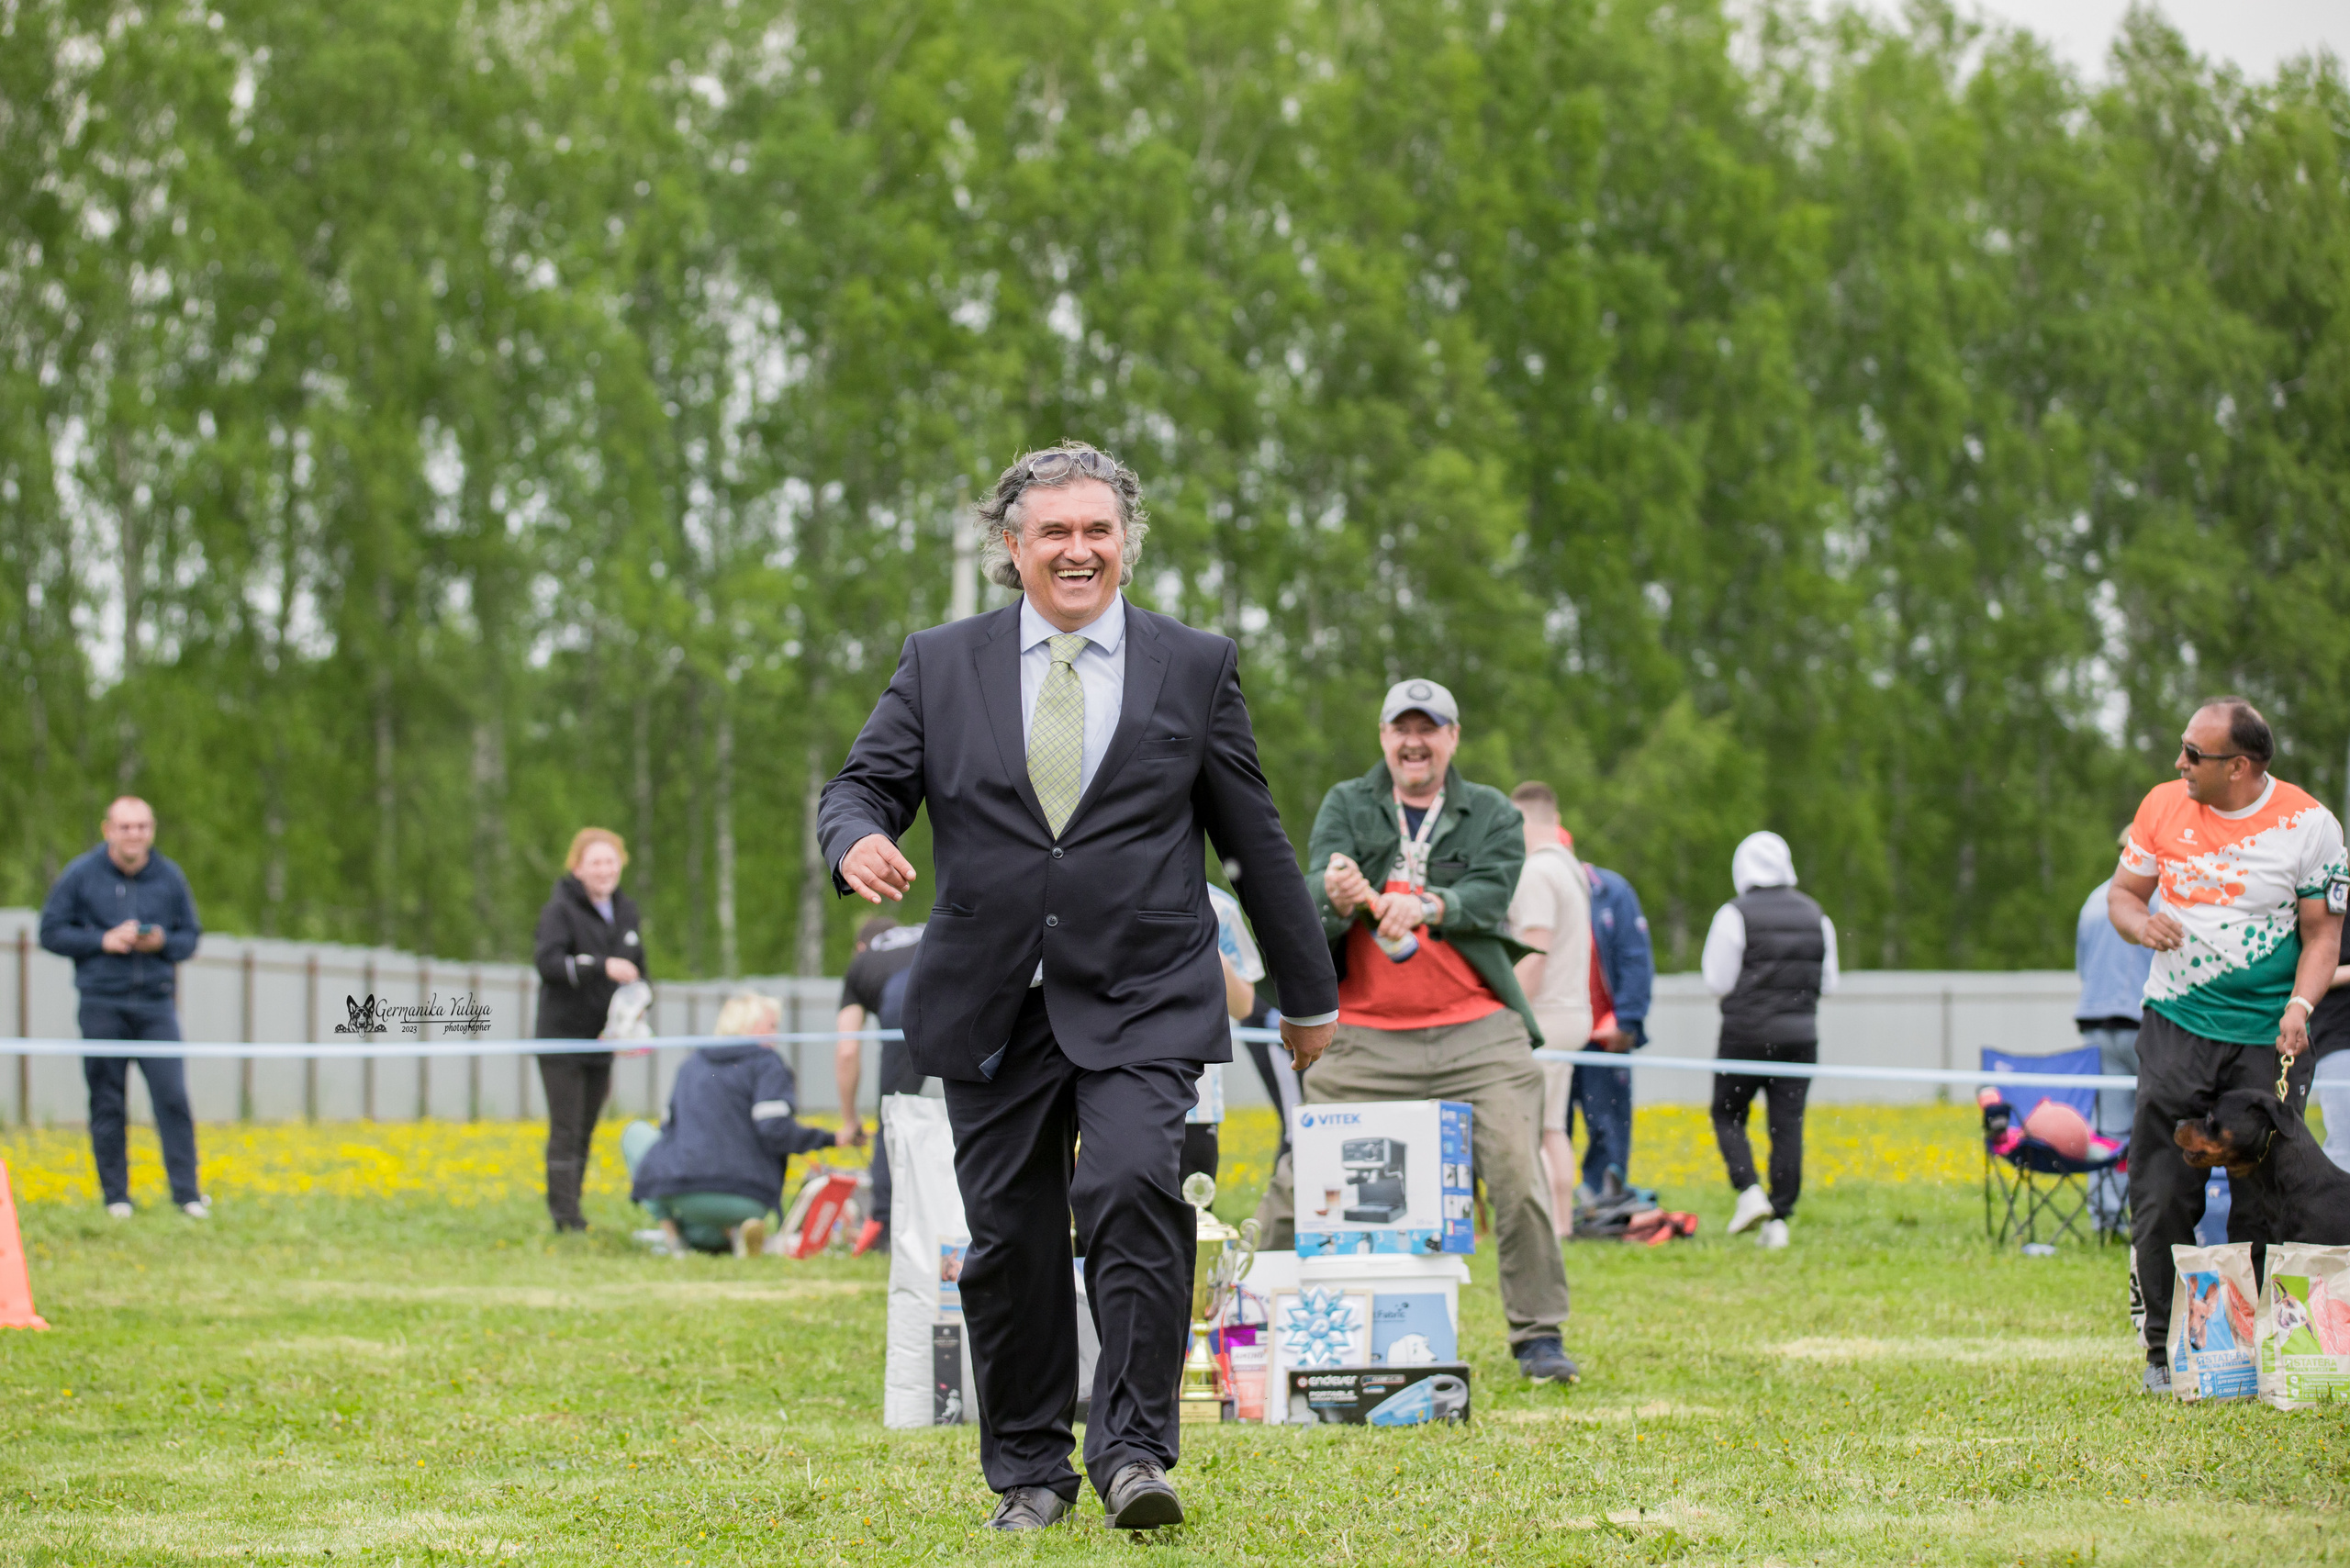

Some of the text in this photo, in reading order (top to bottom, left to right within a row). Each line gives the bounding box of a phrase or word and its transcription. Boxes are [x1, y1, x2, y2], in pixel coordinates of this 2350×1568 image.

[2333, 881, 2344, 902] 6
[1318, 1113, 1360, 1125] VITEK
[1337, 1234, 1345, 1244] 2
[1378, 1232, 1384, 1242] 3
[1412, 1231, 1420, 1241] 4
[2205, 1351, 2249, 1363] STATERA
[2293, 1359, 2337, 1367] STATERA
[1308, 1374, 1359, 1387] endever
